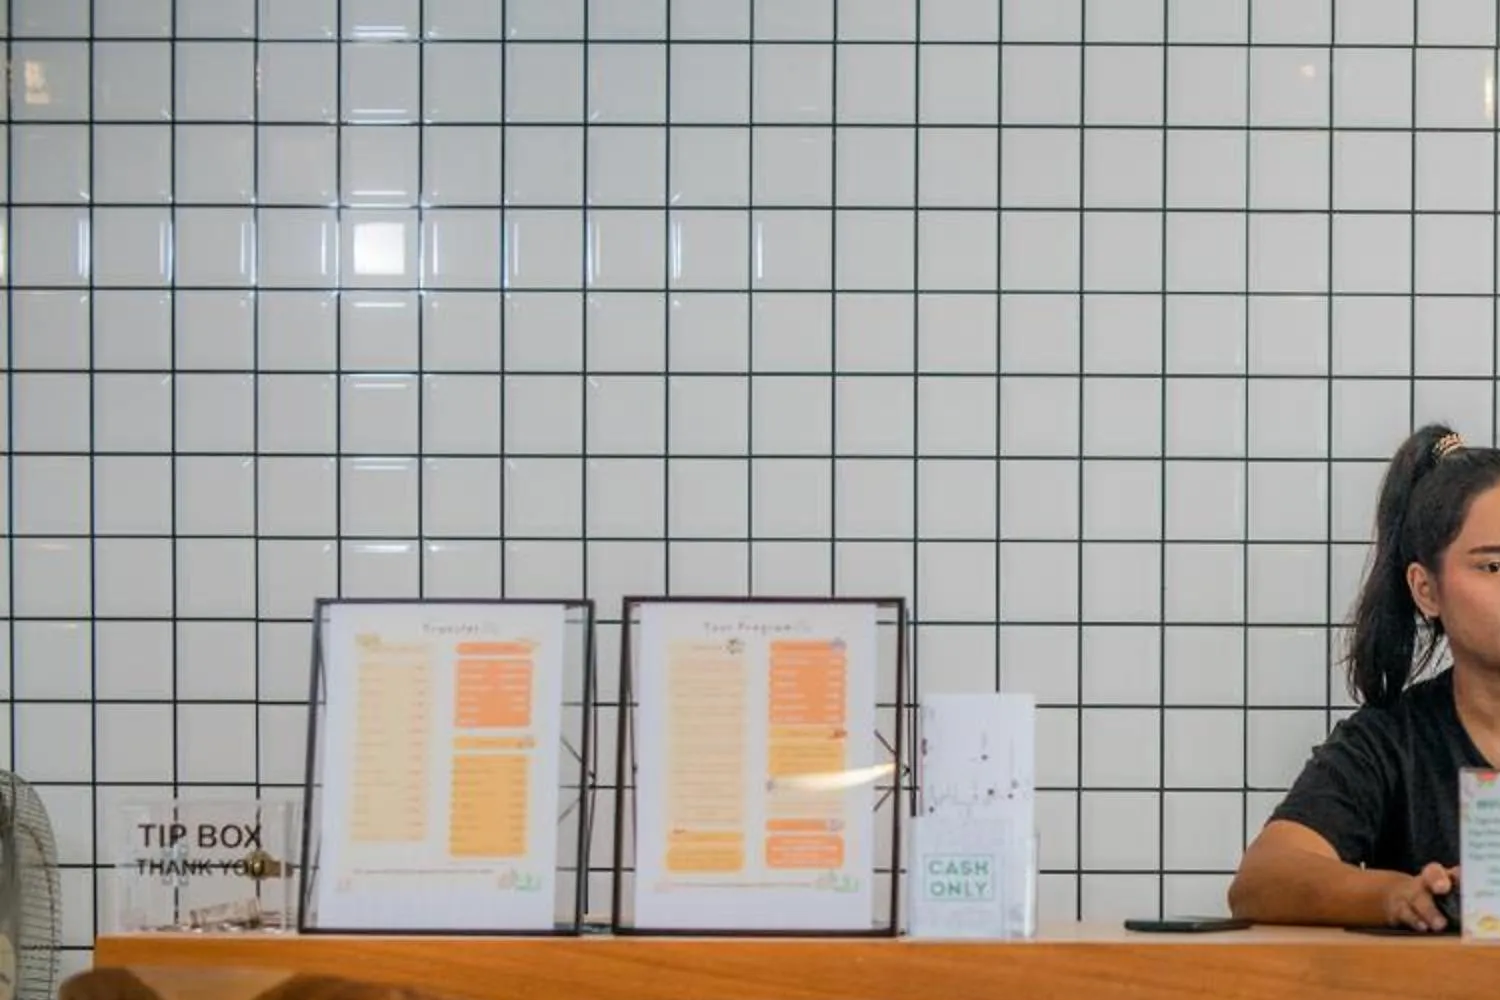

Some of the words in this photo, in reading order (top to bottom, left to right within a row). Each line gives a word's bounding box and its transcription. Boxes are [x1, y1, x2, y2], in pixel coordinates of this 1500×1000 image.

[138, 824, 188, 849] TIP
[197, 824, 262, 849] BOX
[137, 859, 212, 877] THANK
[219, 859, 265, 877] YOU
[928, 860, 989, 876] CASH
[929, 880, 988, 898] ONLY
